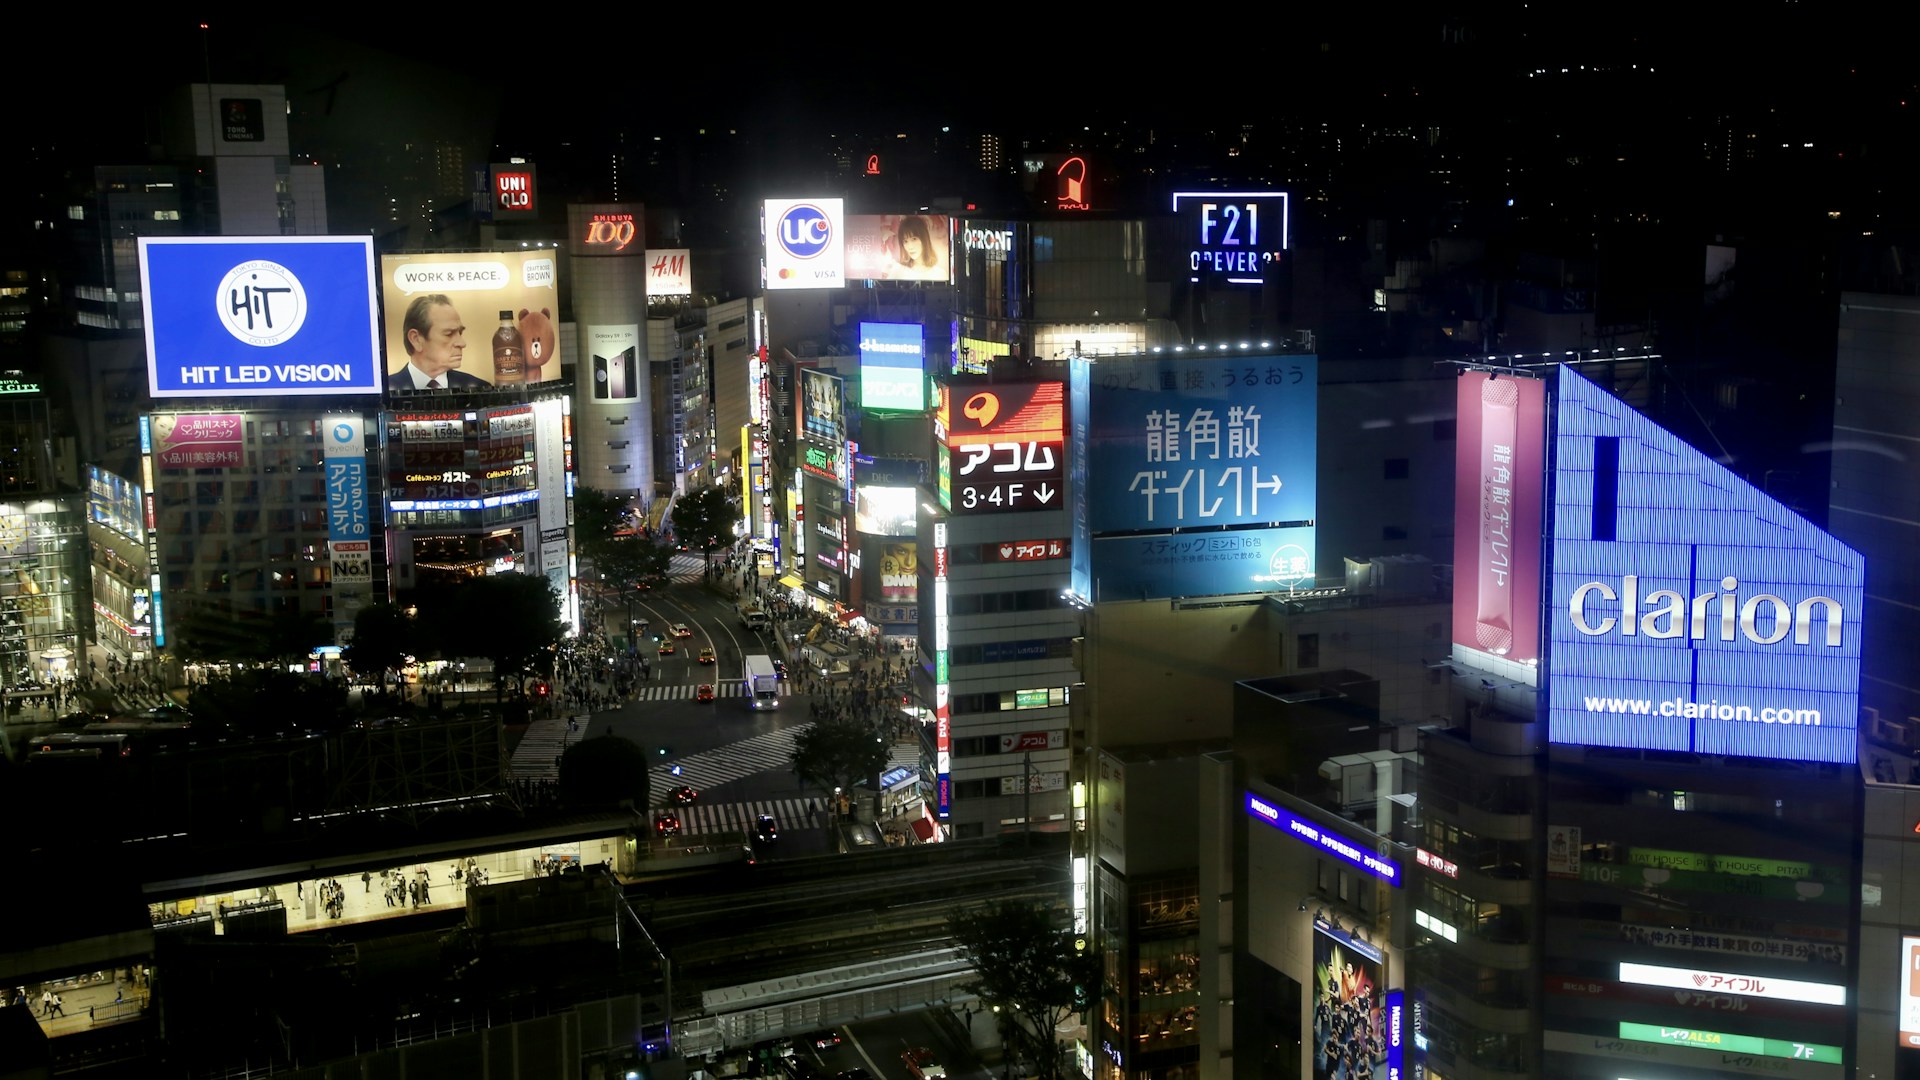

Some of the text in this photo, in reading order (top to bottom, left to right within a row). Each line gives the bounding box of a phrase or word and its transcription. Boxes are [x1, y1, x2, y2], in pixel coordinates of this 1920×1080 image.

[500, 177, 526, 191] UNI
[501, 192, 529, 208] QLO
[783, 217, 827, 245] UC
[1202, 203, 1258, 245] F21
[585, 221, 635, 251] 109
[232, 262, 286, 276] TOKYO GINZA
[652, 254, 685, 278] H&M
[405, 270, 501, 283] WORK & PEACE.
[526, 271, 551, 282] BROWN
[814, 270, 836, 280] VISA
[181, 363, 351, 384] HIT LED VISION
[193, 419, 238, 428] 品川スキン
[193, 429, 234, 439] クリニック
[388, 428, 401, 437] 9F
[1146, 405, 1262, 463] 龍角散
[329, 444, 360, 453] eyecity
[479, 446, 523, 462] コンタクト
[169, 451, 240, 464] 品川美容外科
[959, 440, 1055, 476] アコム
[443, 471, 471, 483] ガスト
[513, 464, 532, 477] ガスト
[872, 472, 893, 482] DHC
[350, 463, 365, 535] コンタクトの
[391, 487, 405, 497] 7F
[425, 485, 460, 498] ガスト
[1128, 465, 1283, 522] ダイレクト
[330, 464, 348, 536] アイシティ
[1490, 444, 1511, 586] 龍角散ダイレクト
[1016, 543, 1061, 558] アイフル
[1142, 537, 1262, 555] スティック ミント 16包
[333, 561, 369, 576] No.1
[1272, 556, 1308, 575] 生薬
[1569, 575, 1844, 648] clarion
[1584, 695, 1821, 727] www.clarion.com
[1022, 736, 1047, 747] アコム
[1251, 798, 1278, 820] MIZUHO
[1653, 855, 1689, 866] HOUSE
[1726, 861, 1763, 873] HOUSE
[1776, 865, 1805, 875] PITAT
[1590, 866, 1621, 882] 10F
[1651, 930, 1720, 951] 仲介手数料
[1587, 983, 1604, 994] 8F
[1709, 974, 1766, 994] アイフル
[1692, 991, 1749, 1013] アイフル
[1391, 1005, 1400, 1047] MIZUHO
[1792, 1043, 1815, 1060] 7F
